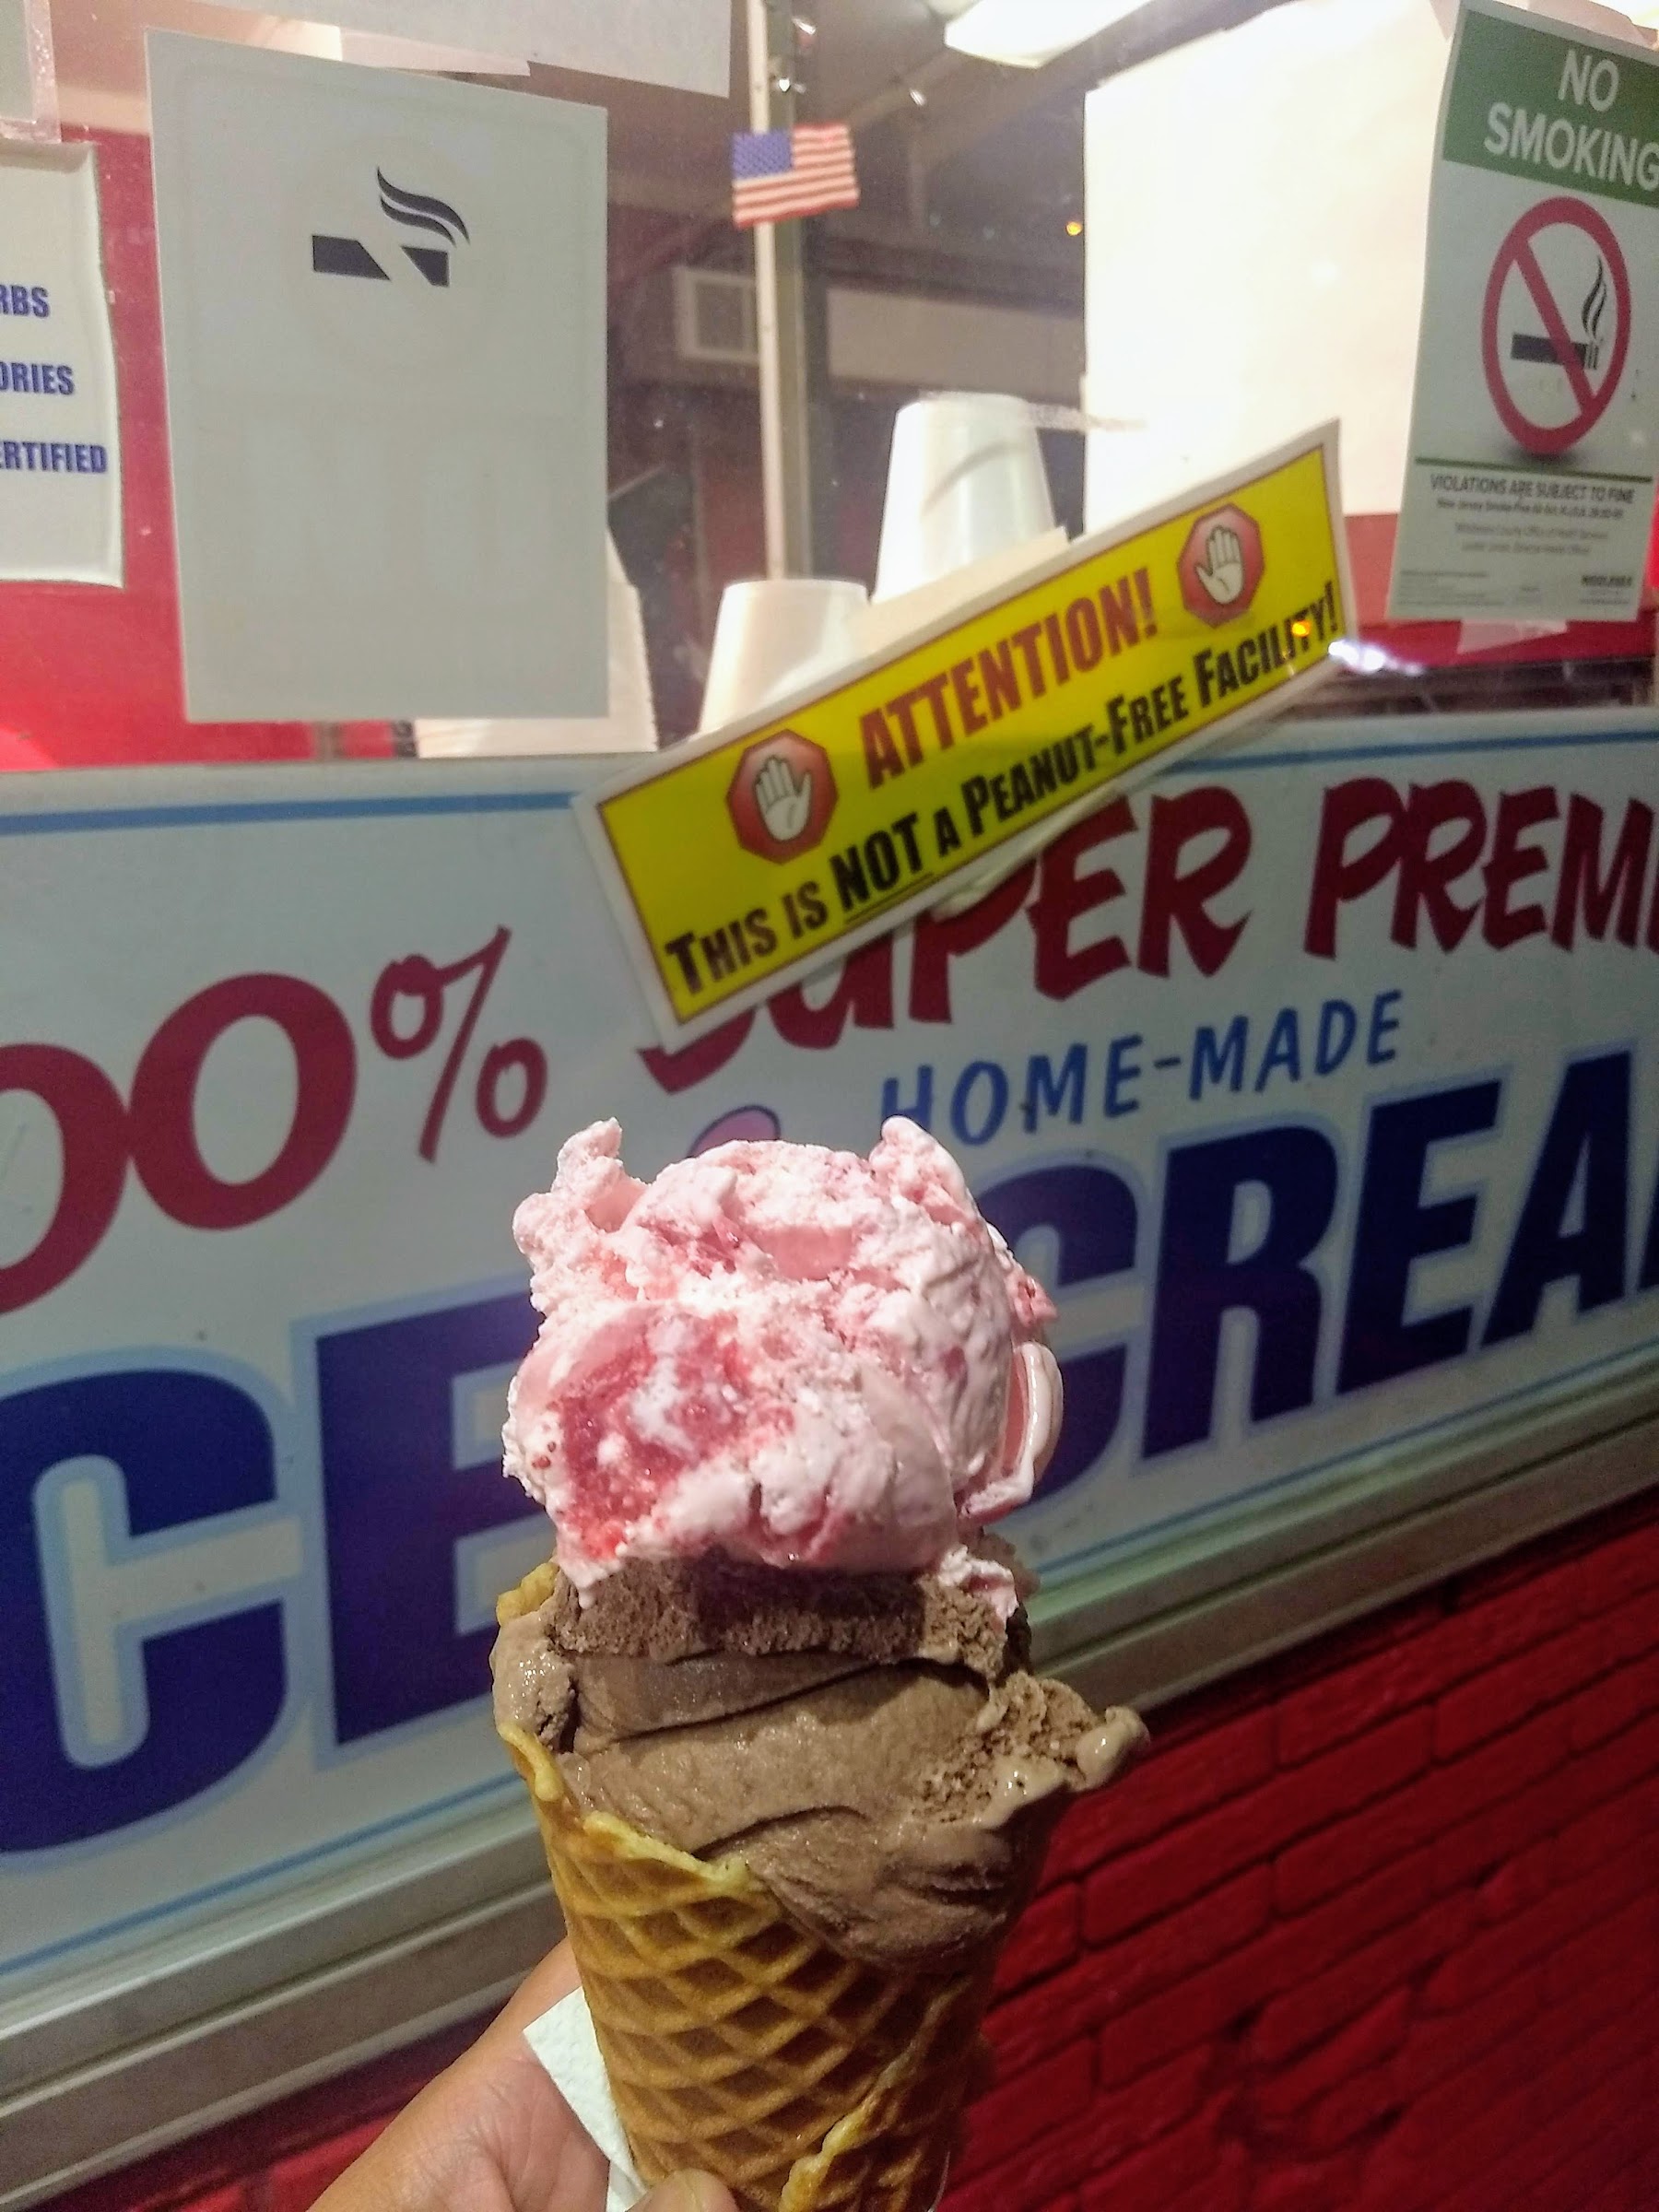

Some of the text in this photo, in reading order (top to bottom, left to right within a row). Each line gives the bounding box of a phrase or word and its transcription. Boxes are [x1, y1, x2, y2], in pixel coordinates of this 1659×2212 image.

[1558, 50, 1619, 112] NO
[1484, 101, 1659, 192] SMOKING
[0, 441, 108, 474] RTIFIED
[858, 566, 1159, 790] ATTENTION!
[830, 812, 924, 914] NOT
[1304, 774, 1659, 961] PREM
[880, 989, 1403, 1147] HOME-MADE
